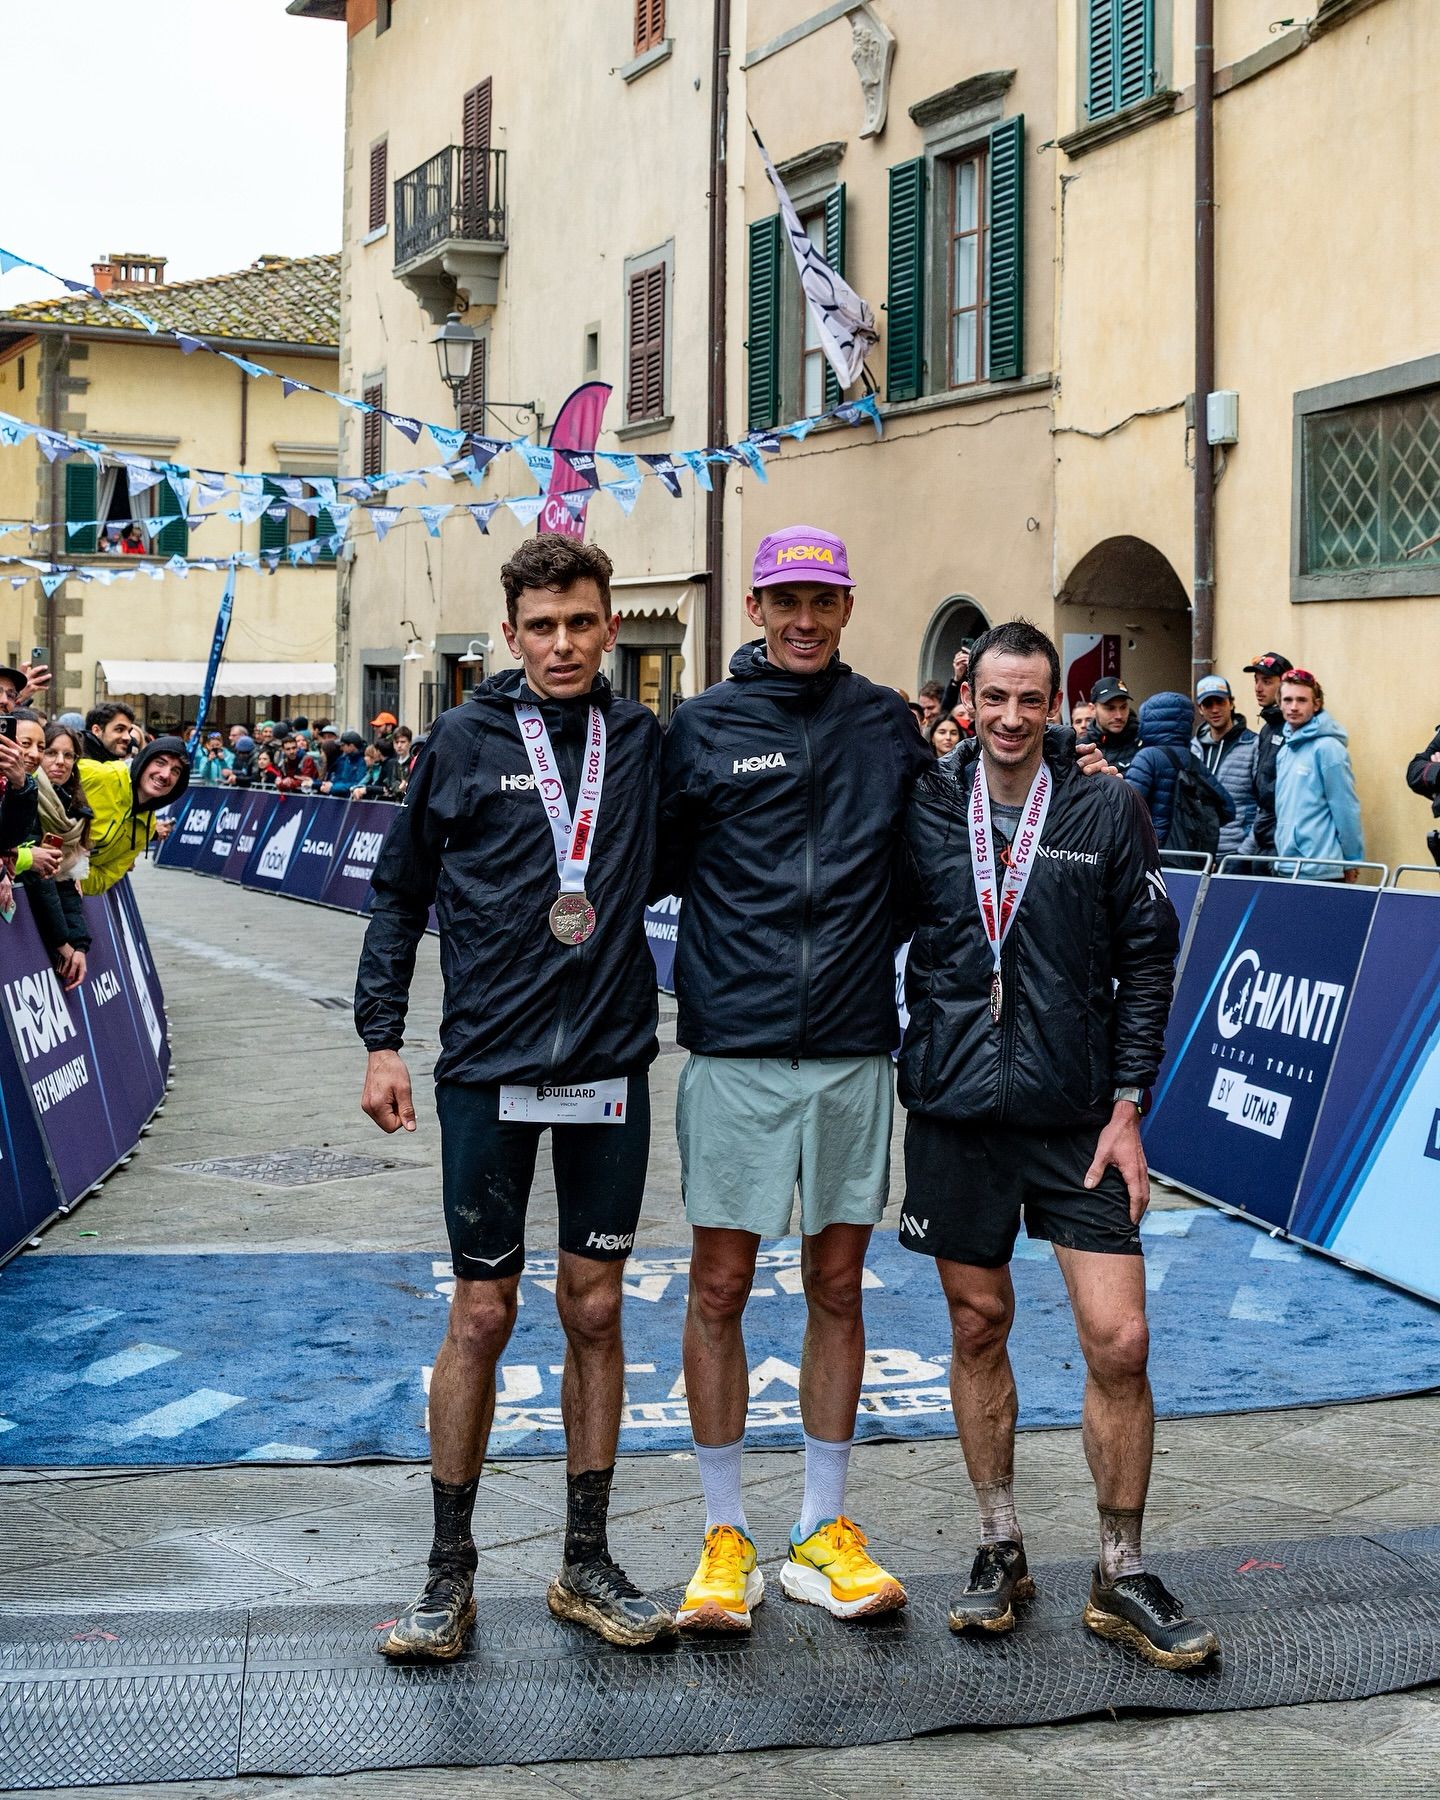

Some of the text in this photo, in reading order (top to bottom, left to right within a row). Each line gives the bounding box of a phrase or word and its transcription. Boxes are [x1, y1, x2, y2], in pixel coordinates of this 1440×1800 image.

[569, 455, 592, 466] UTMB
[776, 545, 834, 566] HOKA
[1108, 641, 1116, 669] SPA
[534, 746, 549, 772] UTCC
[587, 751, 600, 784] 2025
[733, 752, 786, 774] HOKA
[302, 839, 334, 857] DACIA
[347, 831, 383, 863] HOKA
[974, 828, 988, 863] 2025
[1015, 830, 1034, 864] 2025
[1218, 949, 1345, 1045] CHIANTI
[4, 967, 77, 1064] HOKA
[1211, 1043, 1314, 1083] ULTRA TRAIL
[32, 1054, 88, 1114] FLY HUMAN FLY
[541, 1087, 596, 1099] OUILLARD
[1217, 1078, 1278, 1127] BY UTMB
[586, 1231, 635, 1250] HOKA
